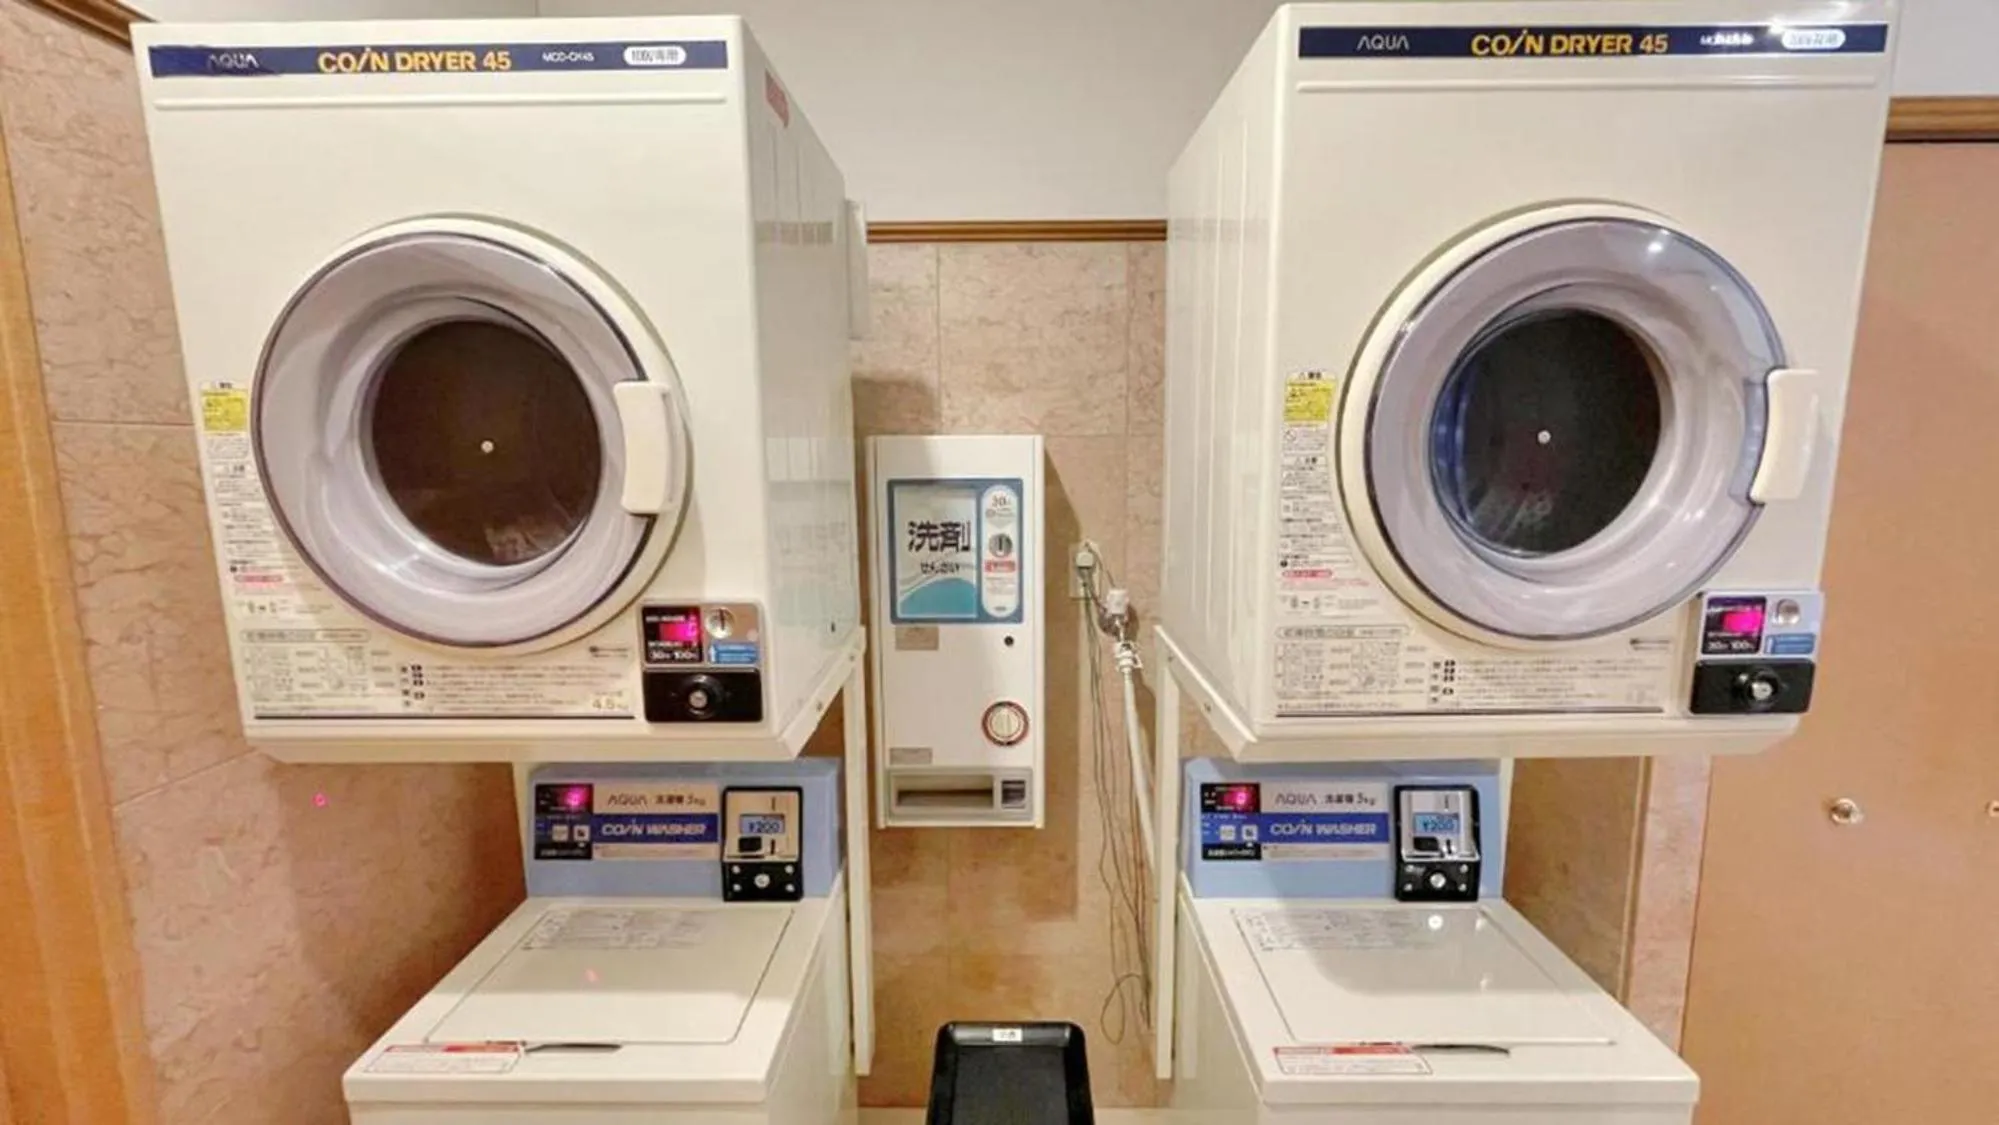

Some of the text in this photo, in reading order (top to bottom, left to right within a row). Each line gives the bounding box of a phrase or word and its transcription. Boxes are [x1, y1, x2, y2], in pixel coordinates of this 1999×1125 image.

[1357, 35, 1409, 52] AQUA
[1550, 35, 1631, 54] DRYER
[1640, 34, 1667, 53] 45
[209, 53, 259, 69] AQUA
[395, 51, 478, 71] DRYER
[483, 50, 512, 69] 45
[908, 520, 971, 553] 洗剤
[608, 794, 648, 806] AQUA
[1275, 793, 1317, 805] AQUA
[646, 823, 706, 835] WASHER
[1316, 823, 1376, 835] WASHER
